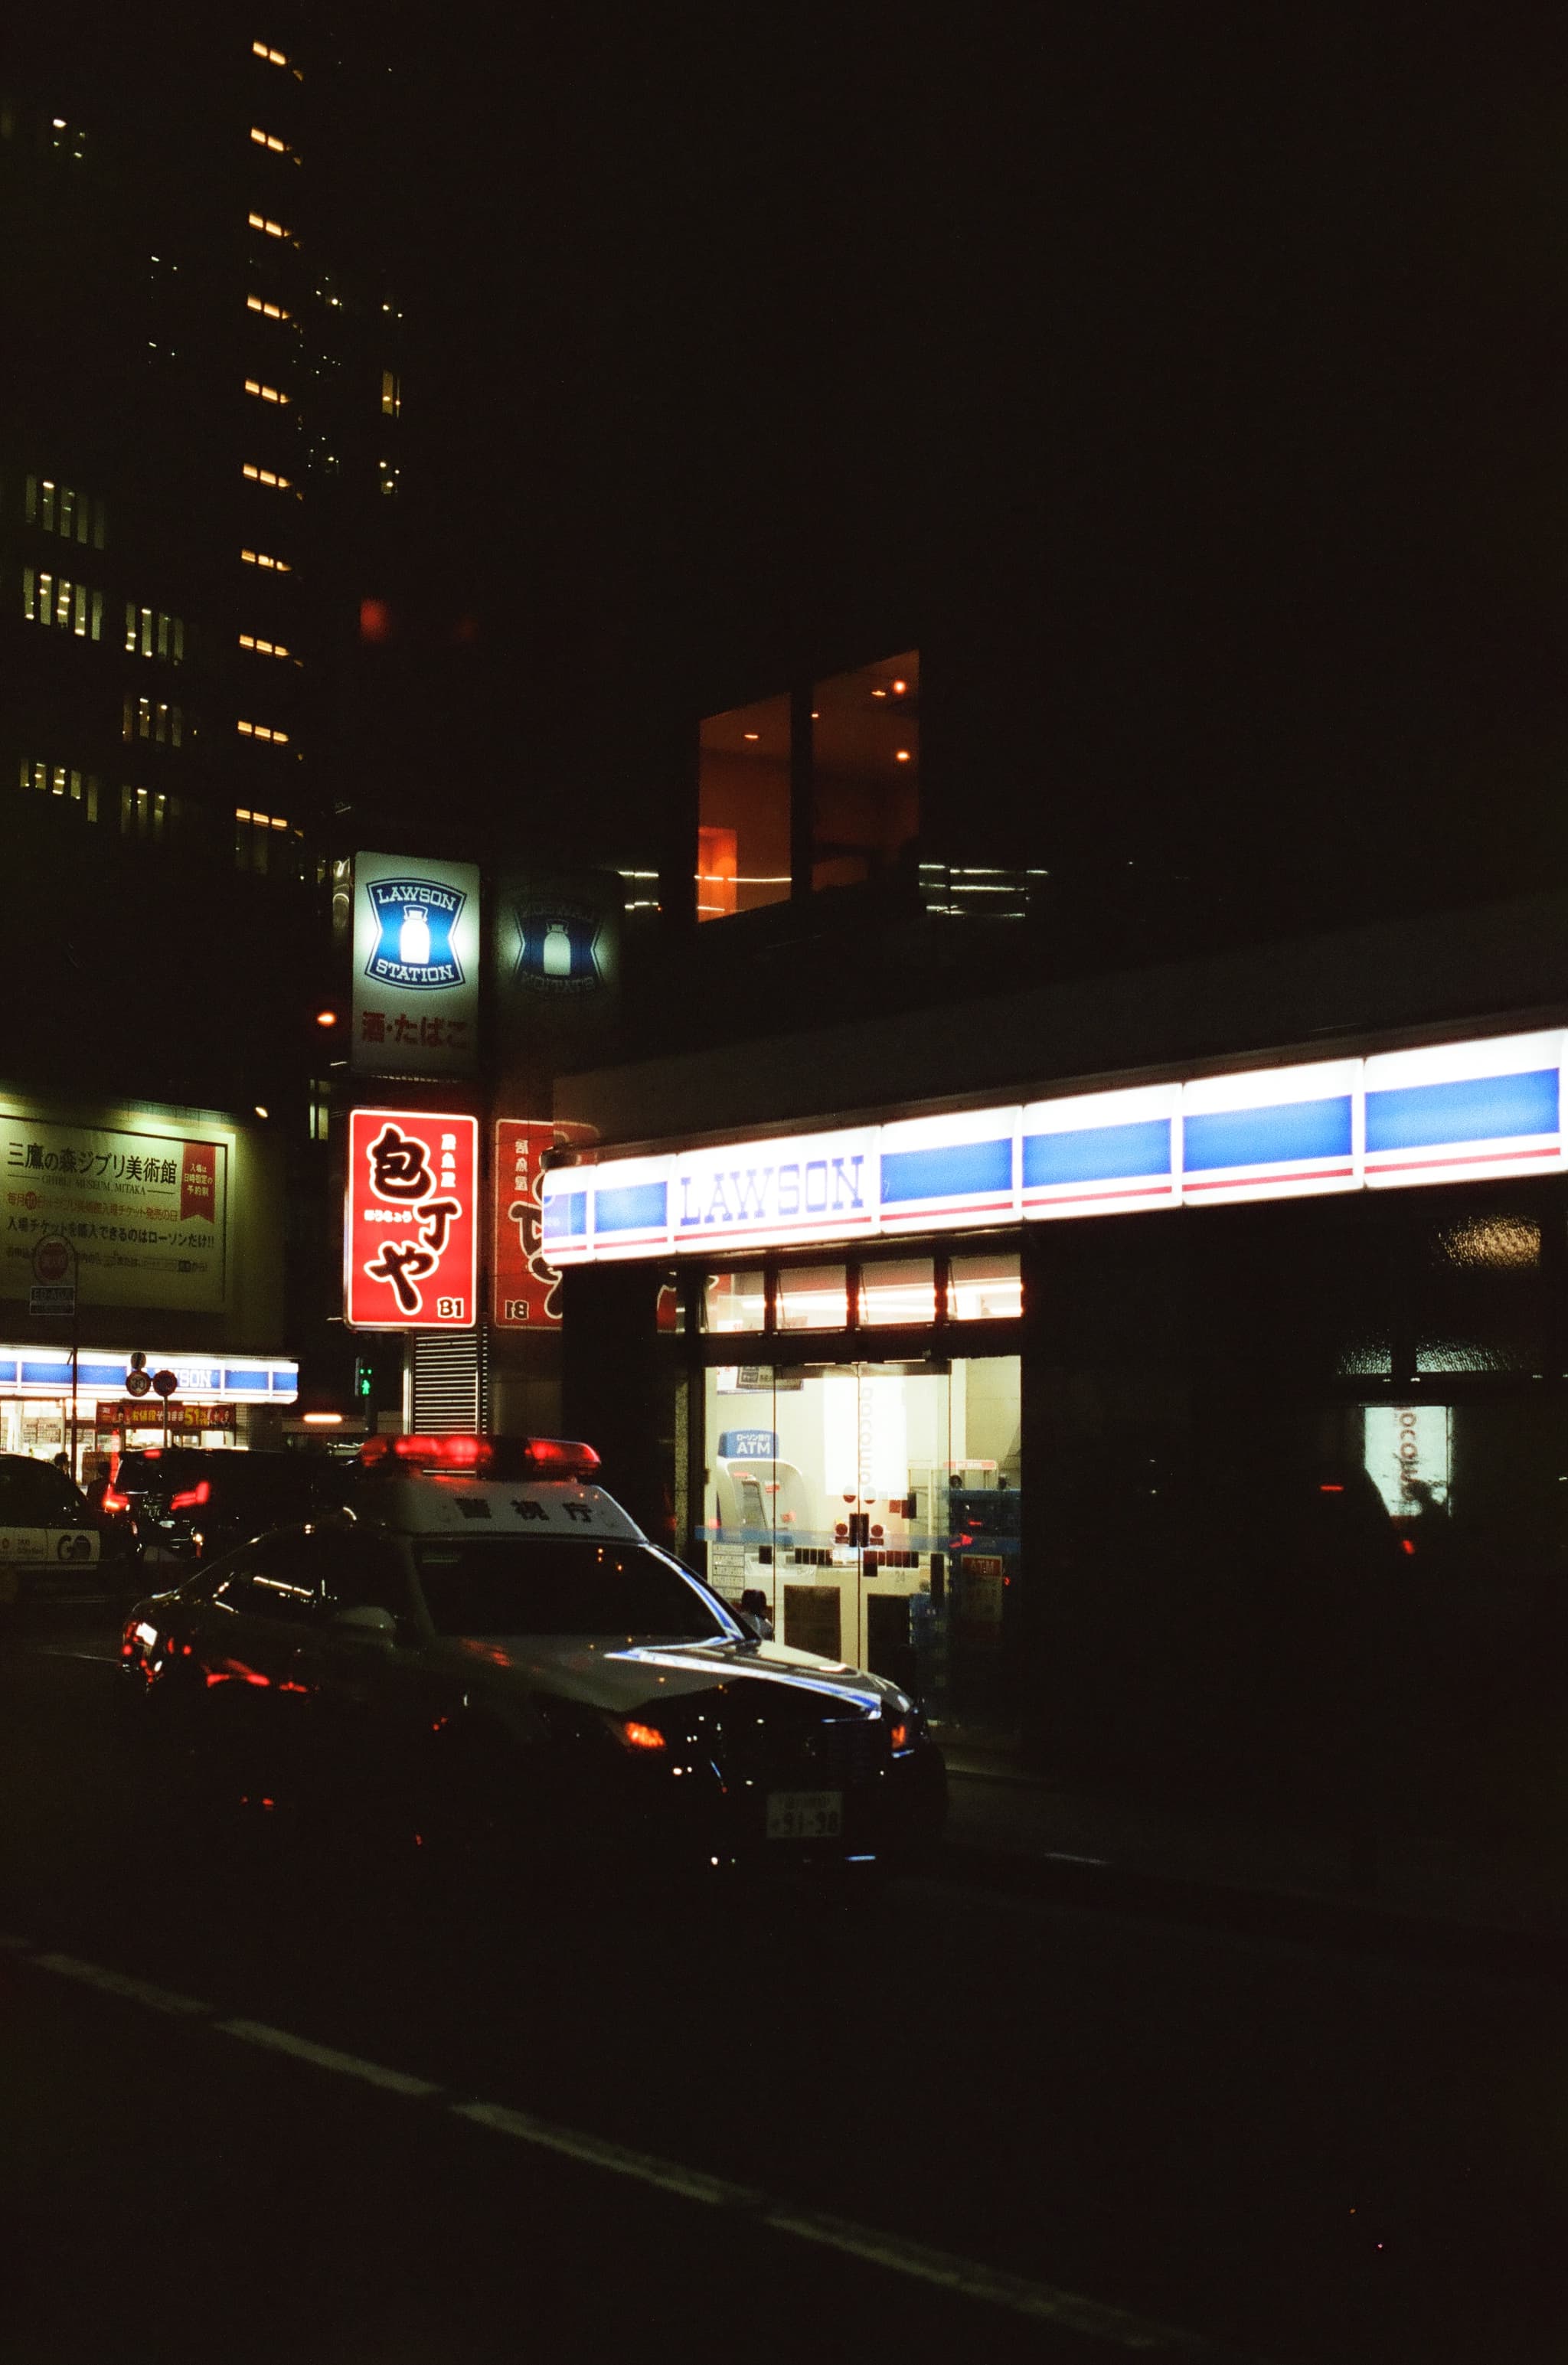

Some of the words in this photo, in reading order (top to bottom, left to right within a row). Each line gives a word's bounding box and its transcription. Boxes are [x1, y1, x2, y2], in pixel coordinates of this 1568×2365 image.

[376, 886, 457, 911] LAWSON
[375, 959, 453, 983] STATION
[8, 1142, 178, 1185] 三鷹の森ジブリ美術館
[680, 1155, 864, 1226] LAWSON
[437, 1296, 464, 1319] B1
[737, 1442, 771, 1455] ATM
